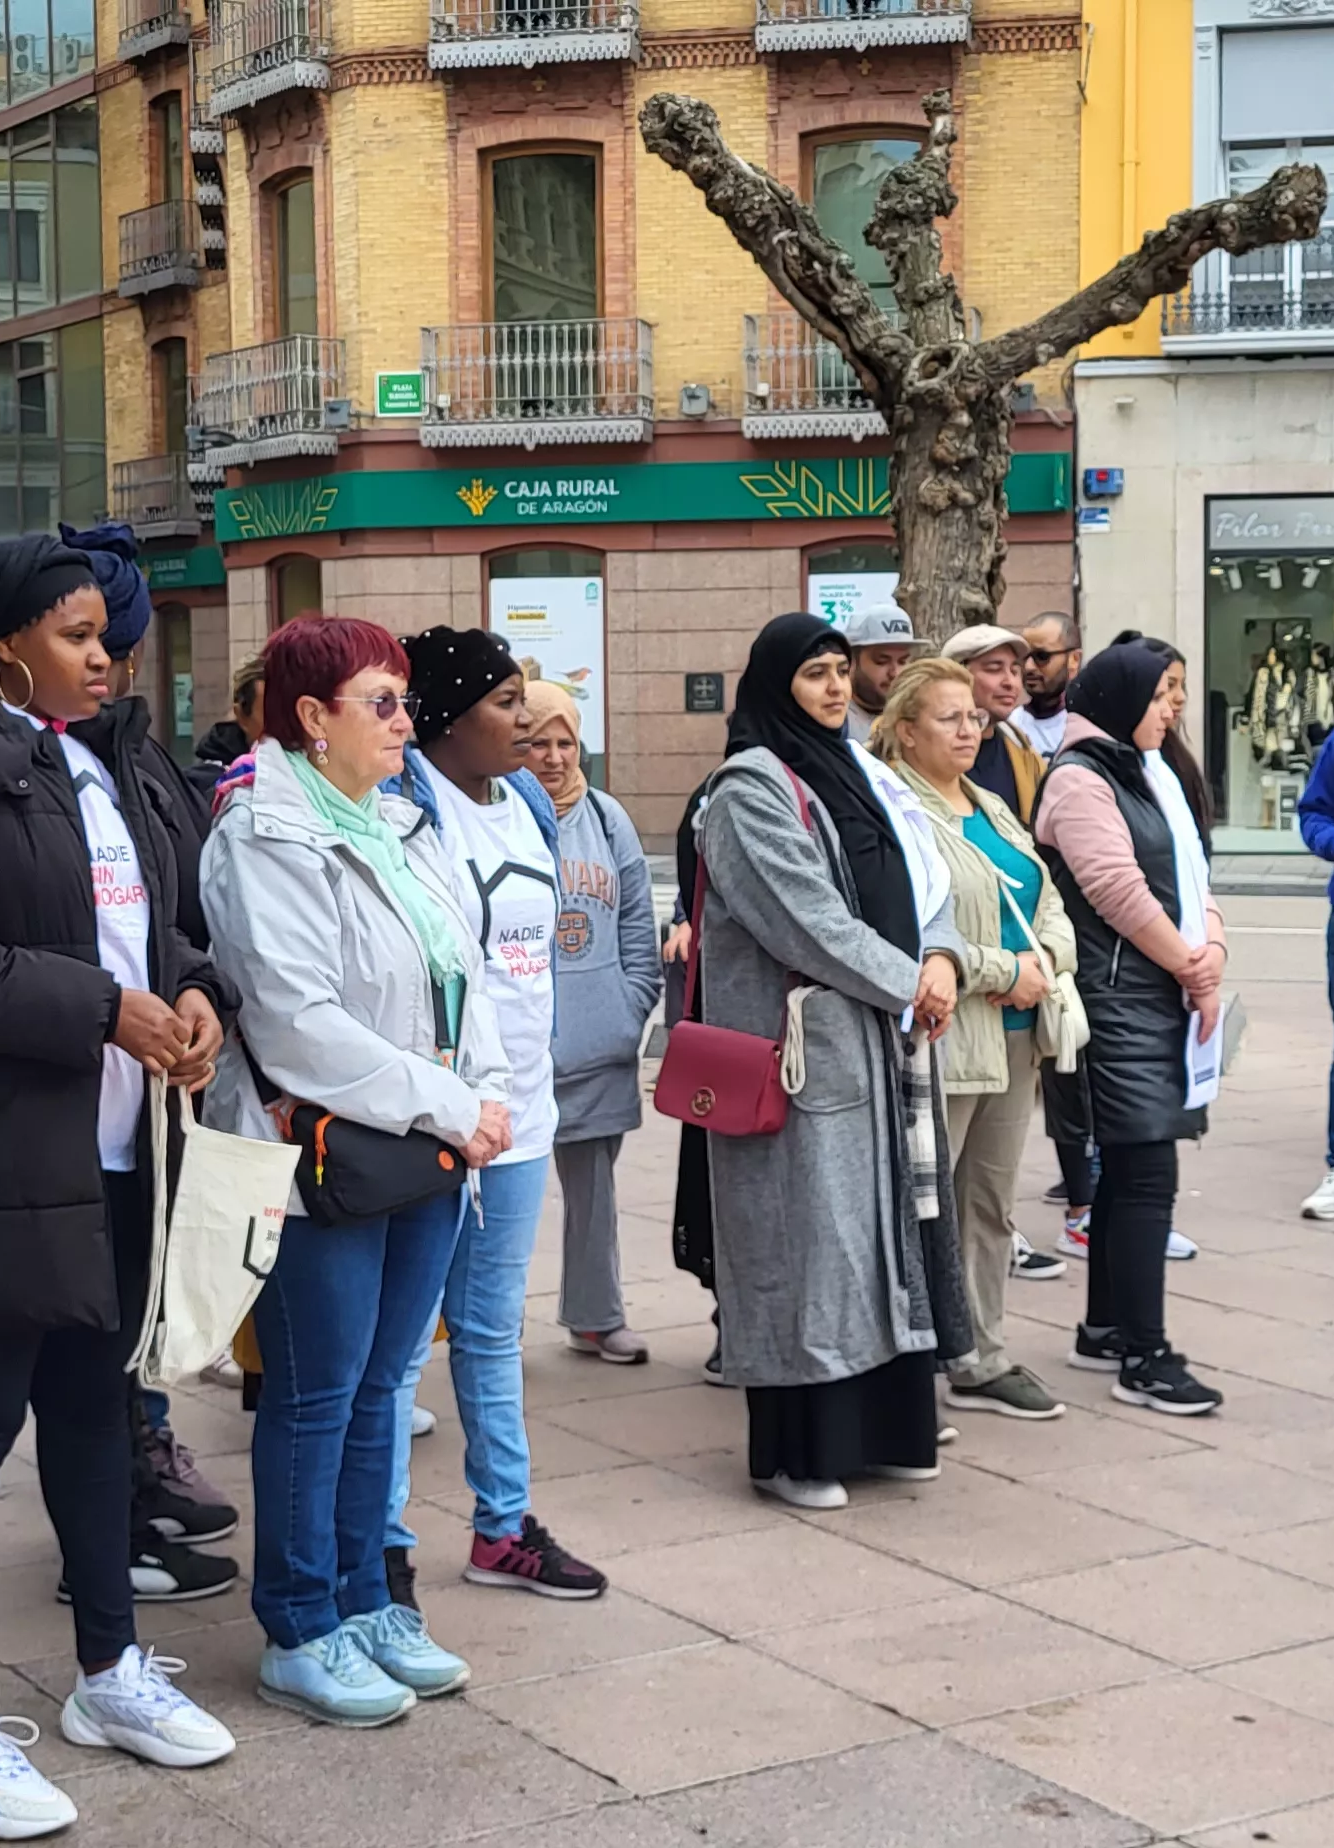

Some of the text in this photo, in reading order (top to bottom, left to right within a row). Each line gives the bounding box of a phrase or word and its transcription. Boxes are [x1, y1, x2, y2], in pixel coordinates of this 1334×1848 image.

[504, 479, 620, 498] CAJA RURAL
[517, 499, 608, 515] DE ARAGÓN
[1216, 512, 1284, 538] Pilar
[88, 845, 130, 862] ADIE
[497, 924, 545, 944] NADIE
[499, 943, 528, 960] SIN
